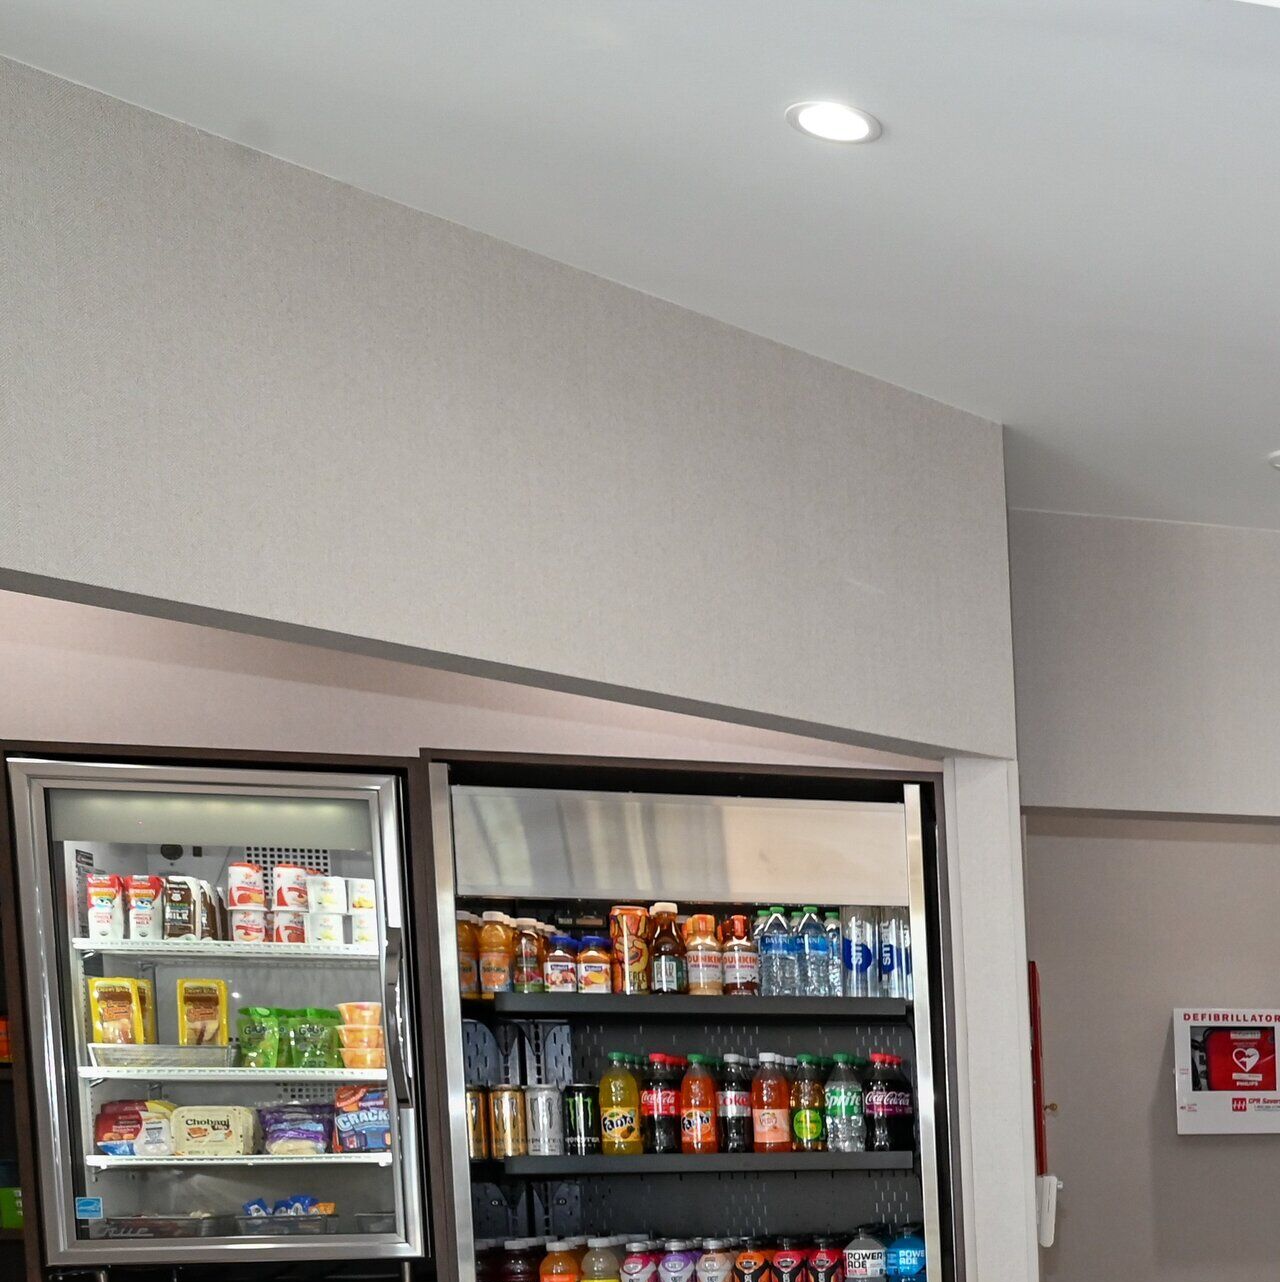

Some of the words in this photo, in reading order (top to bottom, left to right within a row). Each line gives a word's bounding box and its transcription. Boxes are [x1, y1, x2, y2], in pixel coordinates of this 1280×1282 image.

[824, 1092, 860, 1107] Sprite
[185, 1118, 230, 1126] Chobani
[603, 1116, 634, 1133] Fanta
[682, 1115, 710, 1132] Fanta
[847, 1252, 883, 1261] POWER
[847, 1260, 868, 1268] ADE
